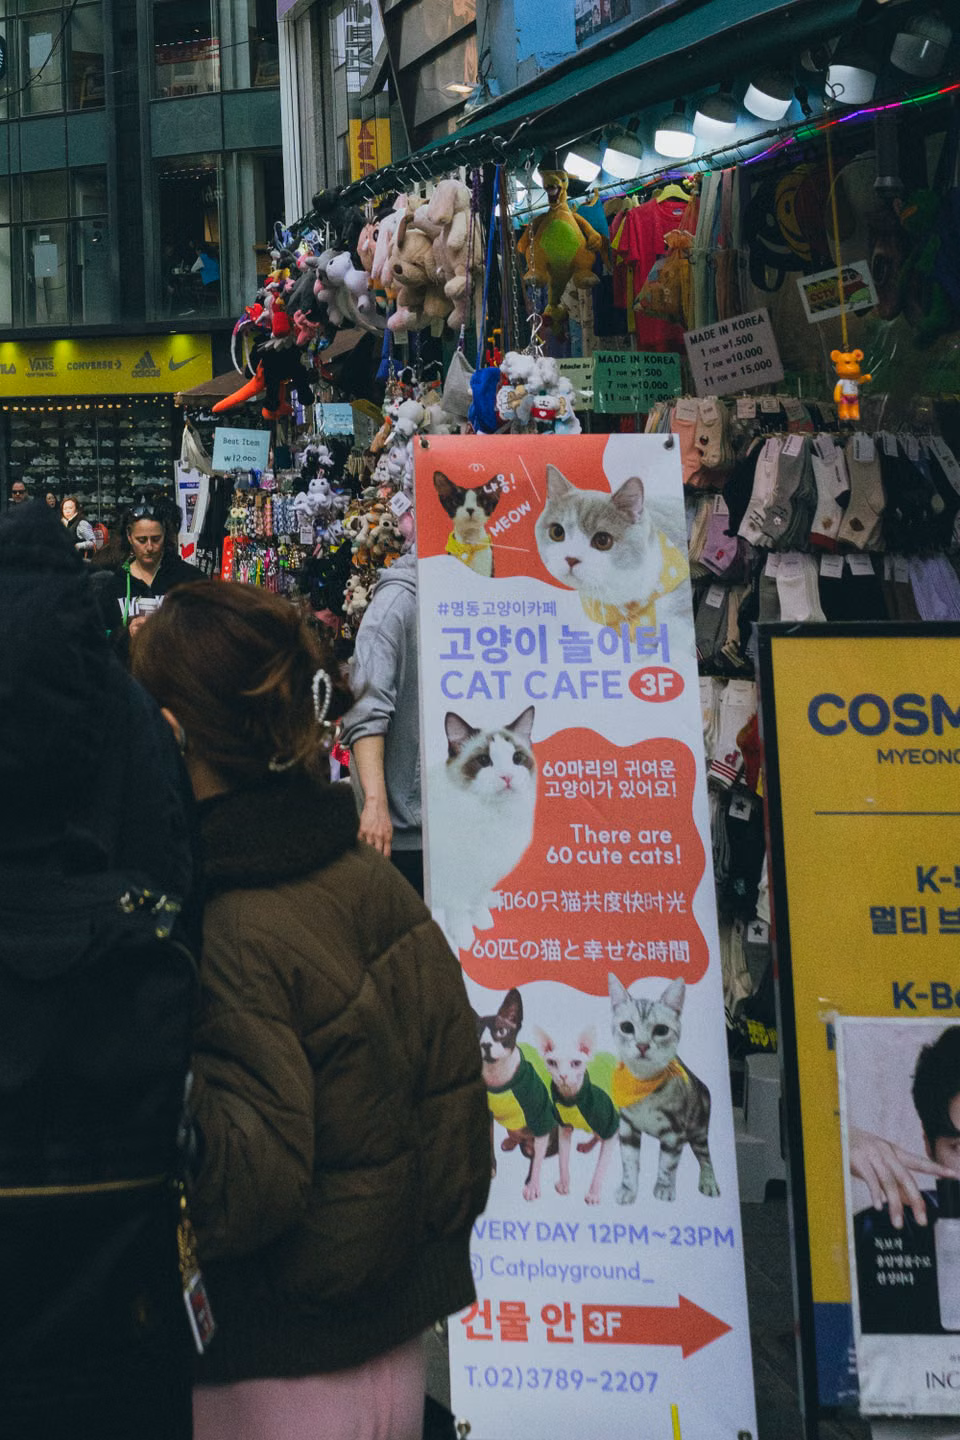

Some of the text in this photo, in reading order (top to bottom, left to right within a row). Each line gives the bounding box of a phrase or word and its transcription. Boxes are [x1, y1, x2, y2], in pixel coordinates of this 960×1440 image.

[689, 313, 765, 346] MADE IN KOREA
[27, 356, 56, 371] VANS
[66, 360, 113, 371] CONVERSE
[598, 355, 676, 365] MADE IN KOREA
[703, 376, 715, 387] 11
[604, 393, 615, 402] 11
[222, 436, 261, 447] Best Item
[483, 472, 516, 496] 냐옹!
[488, 499, 533, 538] MEOW
[437, 600, 557, 617] #명동고양이카페
[439, 623, 671, 665] 고양이 놀이터
[440, 669, 674, 700] CAT CAFE 3F
[542, 759, 676, 779] 60마리의 귀여운
[544, 780, 677, 799] 고양이가 있어요!
[569, 823, 672, 845] There are
[546, 844, 682, 865] 60 cute cats!
[916, 865, 960, 894] K-
[869, 905, 928, 935] 멀티
[471, 937, 691, 964] 60匹の猫と幸せな時間
[472, 1220, 735, 1250] VERY DAY 12PM~23PM
[490, 1255, 655, 1285] Catplayground_
[460, 1298, 623, 1344] 건물 안 3F
[464, 1365, 659, 1394] T.02)3789-2207
